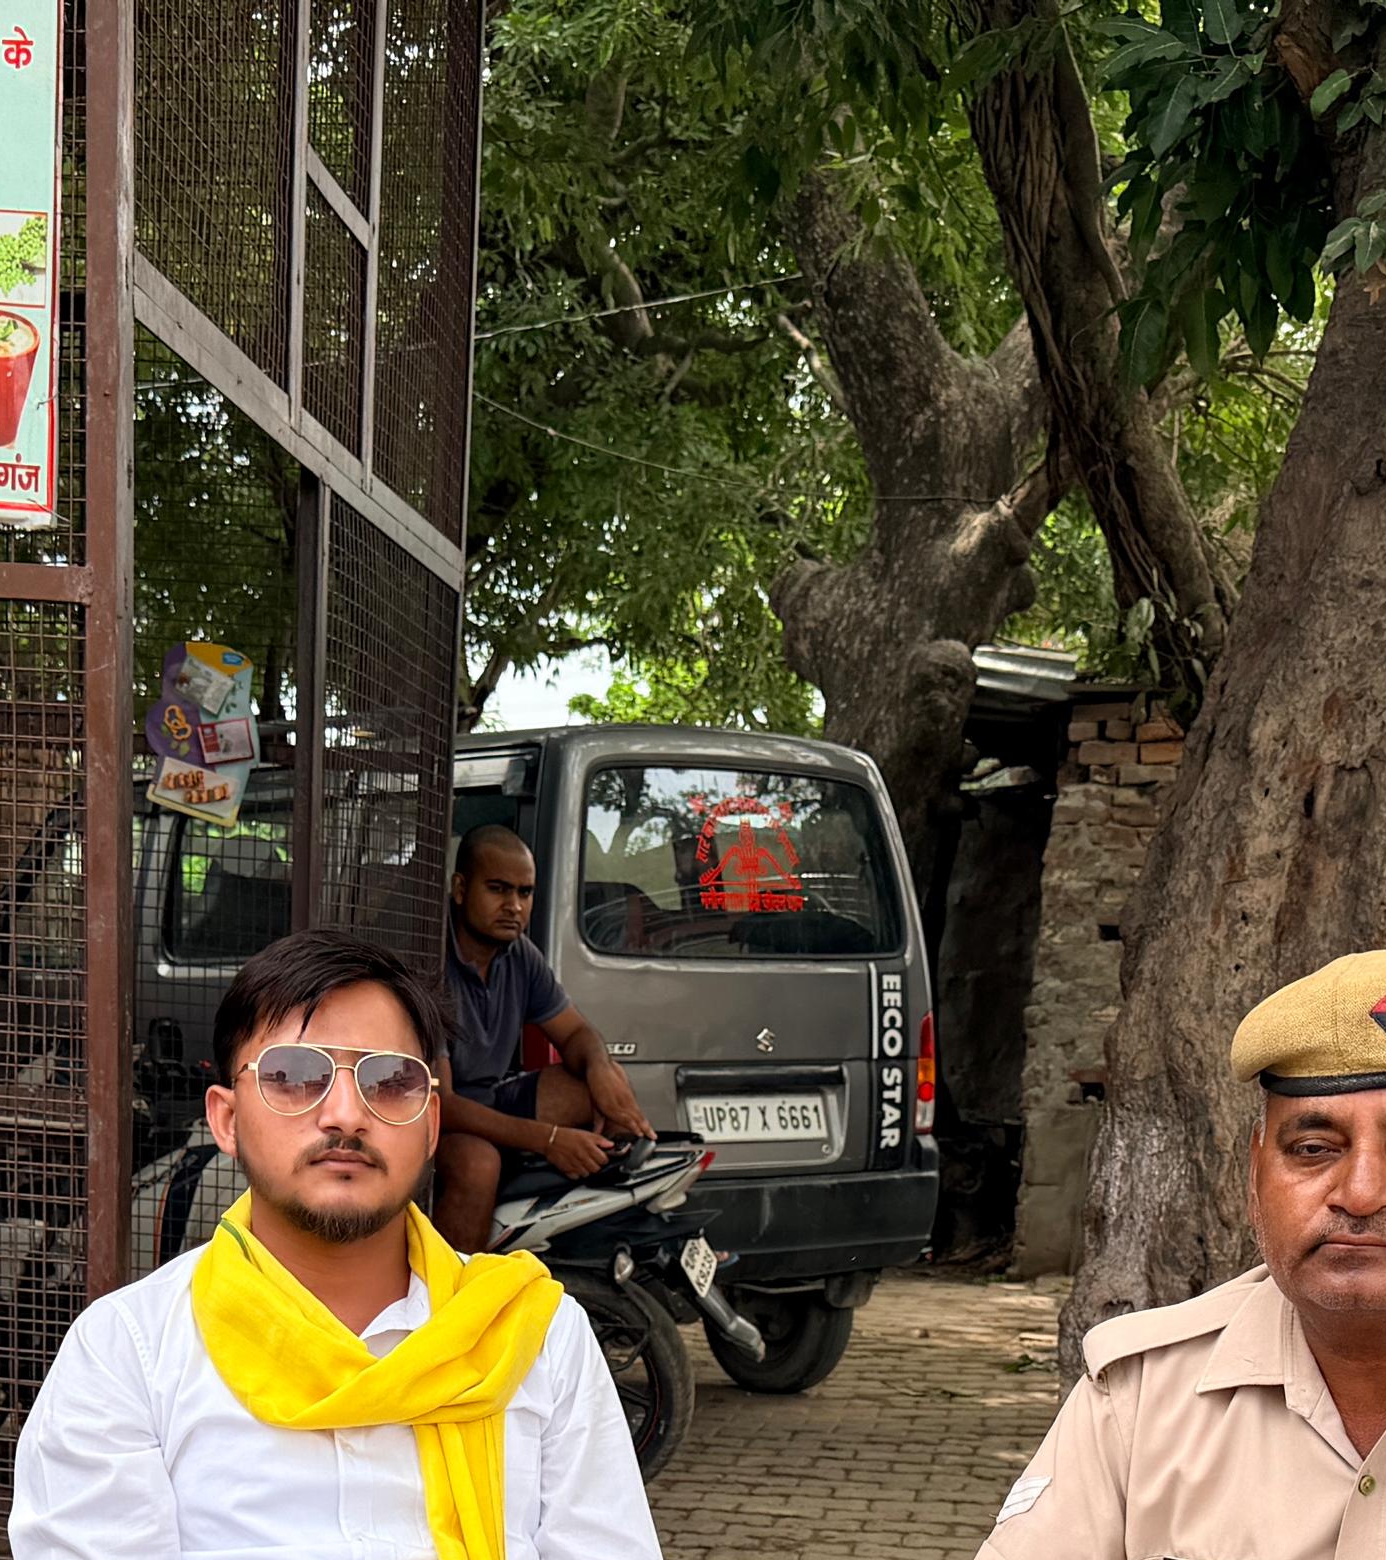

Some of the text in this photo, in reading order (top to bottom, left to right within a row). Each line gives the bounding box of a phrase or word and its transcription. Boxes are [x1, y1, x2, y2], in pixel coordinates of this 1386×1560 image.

[3, 27, 33, 68] के
[880, 974, 904, 1150] EECO STAR
[703, 1106, 750, 1132] UP87
[758, 1106, 770, 1131] X
[777, 1105, 821, 1130] 6661
